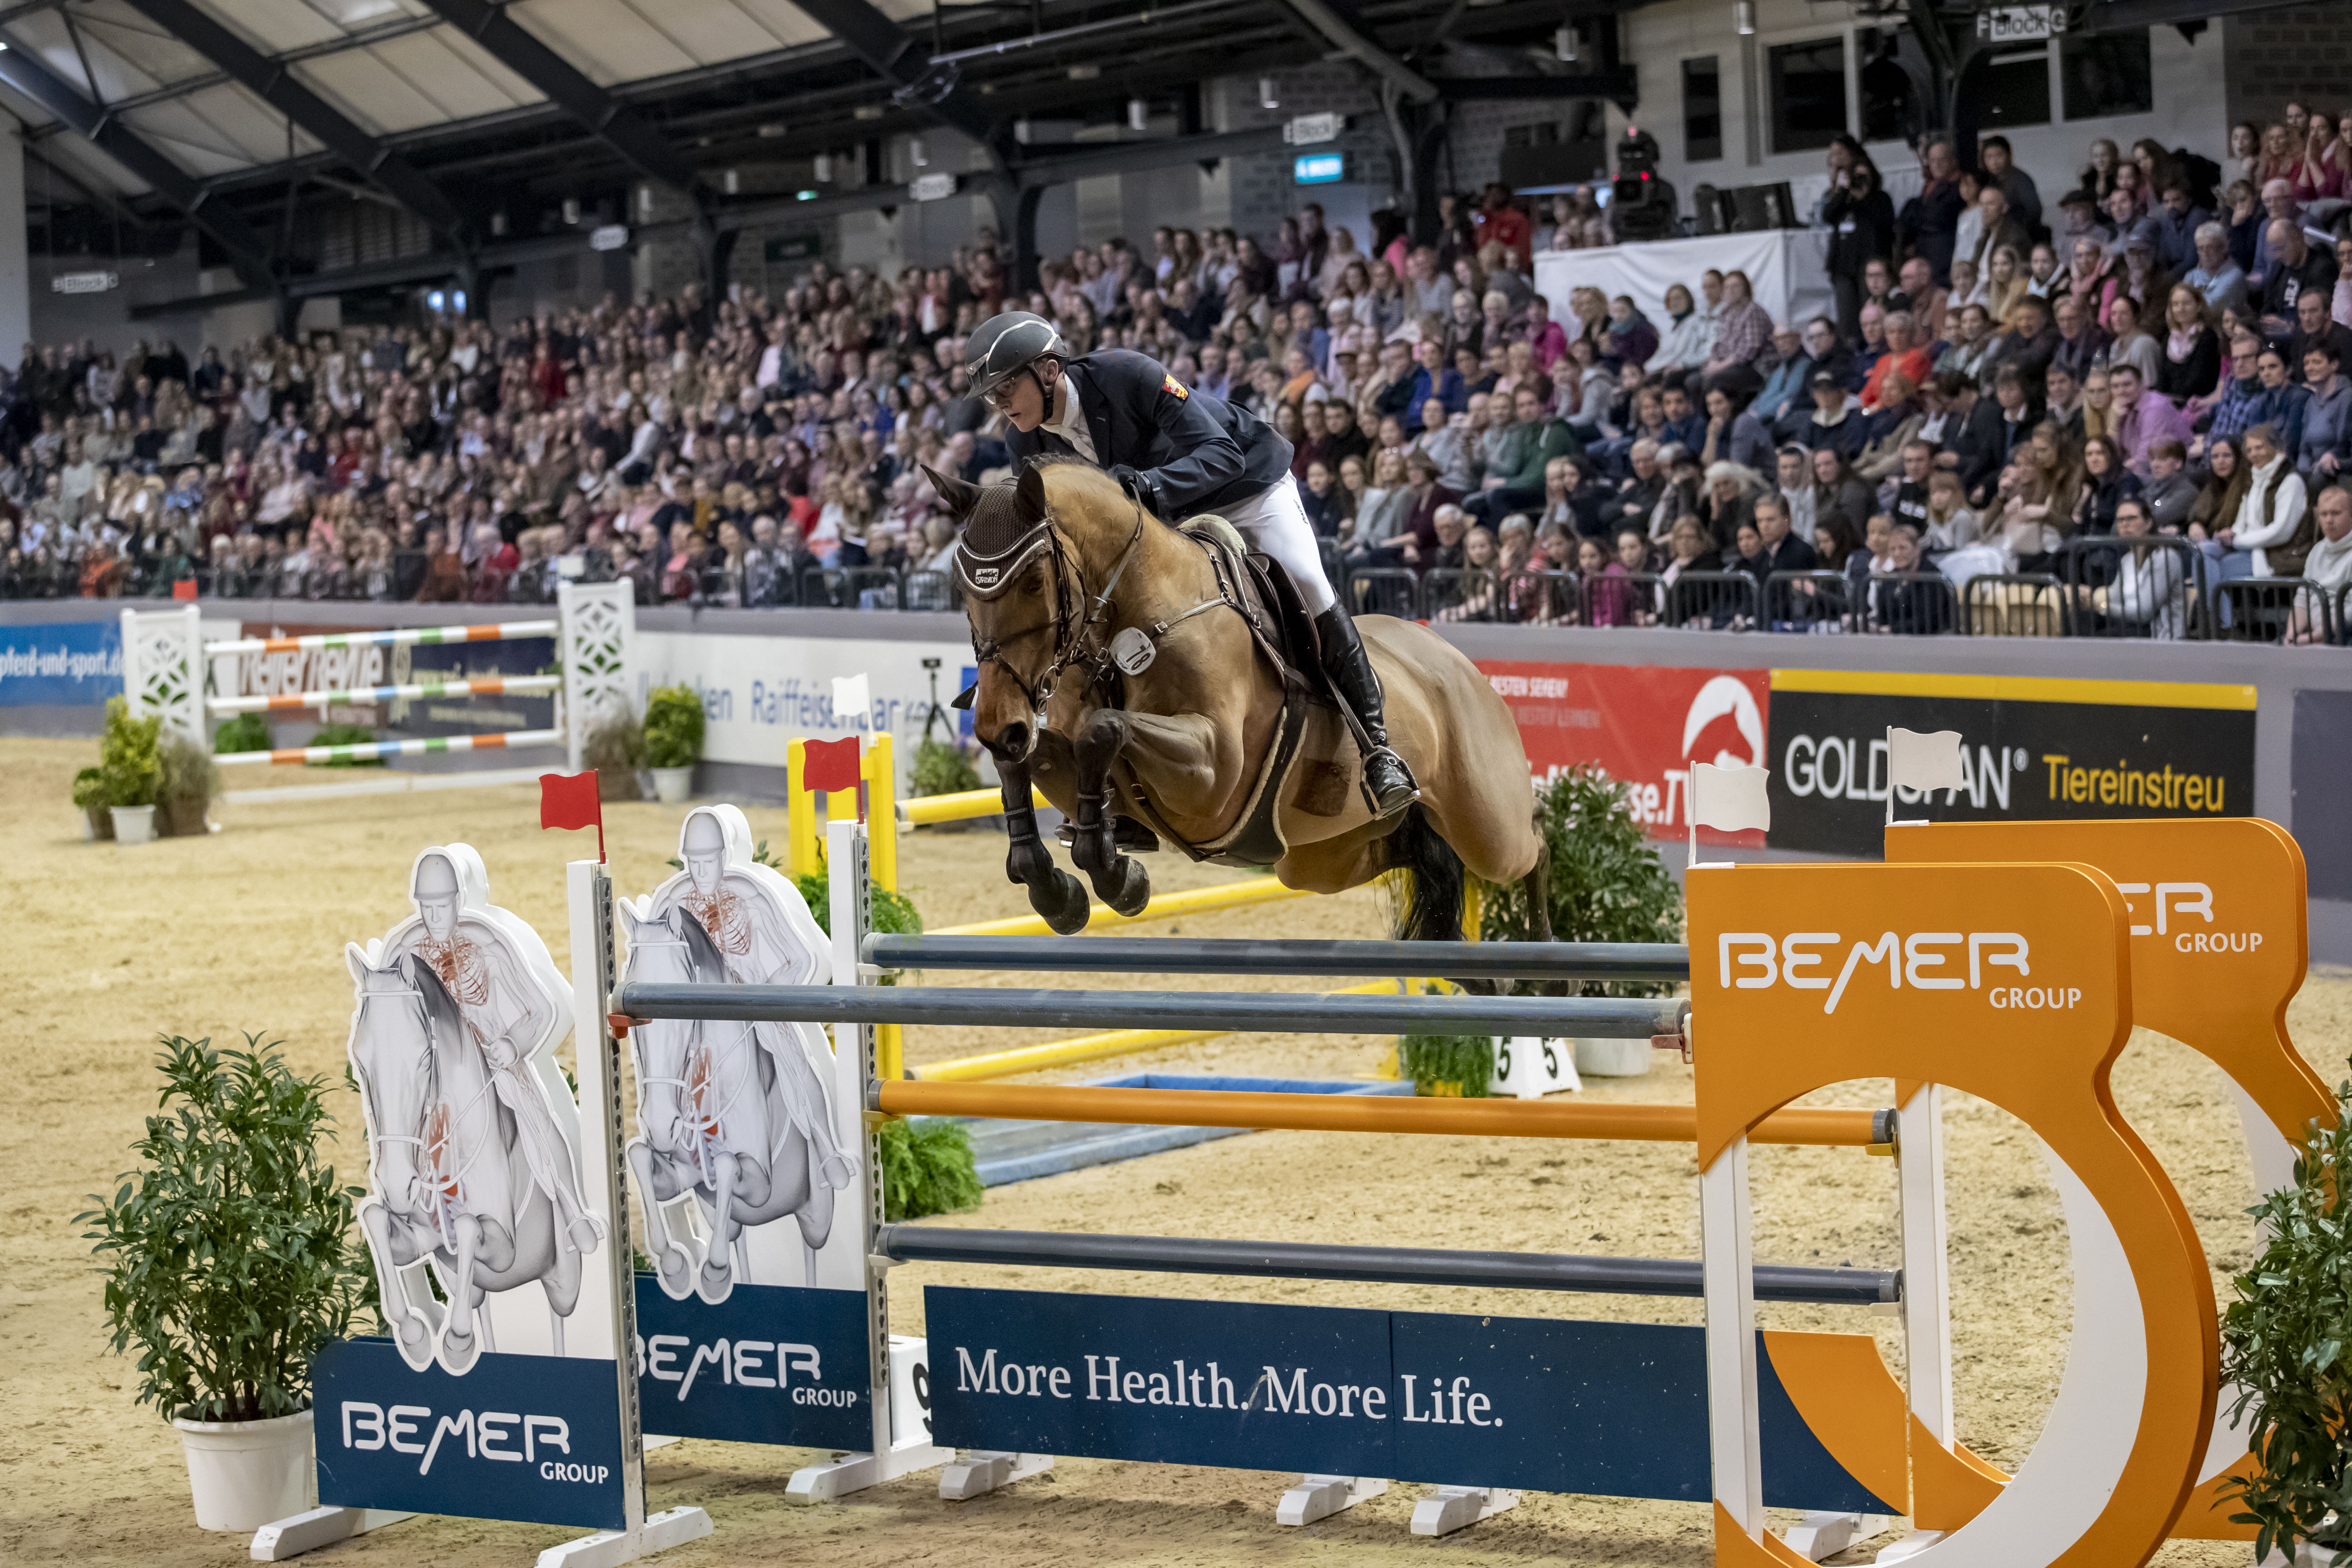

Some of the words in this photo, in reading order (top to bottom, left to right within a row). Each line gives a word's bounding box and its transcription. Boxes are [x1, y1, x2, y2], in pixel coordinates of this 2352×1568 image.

[2043, 754, 2225, 812] Tiereinstreu
[2175, 933, 2263, 952] GROUP
[1718, 931, 2030, 1014] BEMER
[1989, 987, 2082, 1009] GROUP
[1497, 1036, 1511, 1082] 5
[1542, 1037, 1558, 1079] 5
[792, 1386, 857, 1408] GROUP
[955, 1347, 1071, 1398] More
[1085, 1355, 1250, 1411] Health.
[1263, 1366, 1387, 1419] More
[1401, 1374, 1503, 1427] Life.
[341, 1401, 570, 1476] BEMER
[540, 1461, 609, 1484] GROUP
